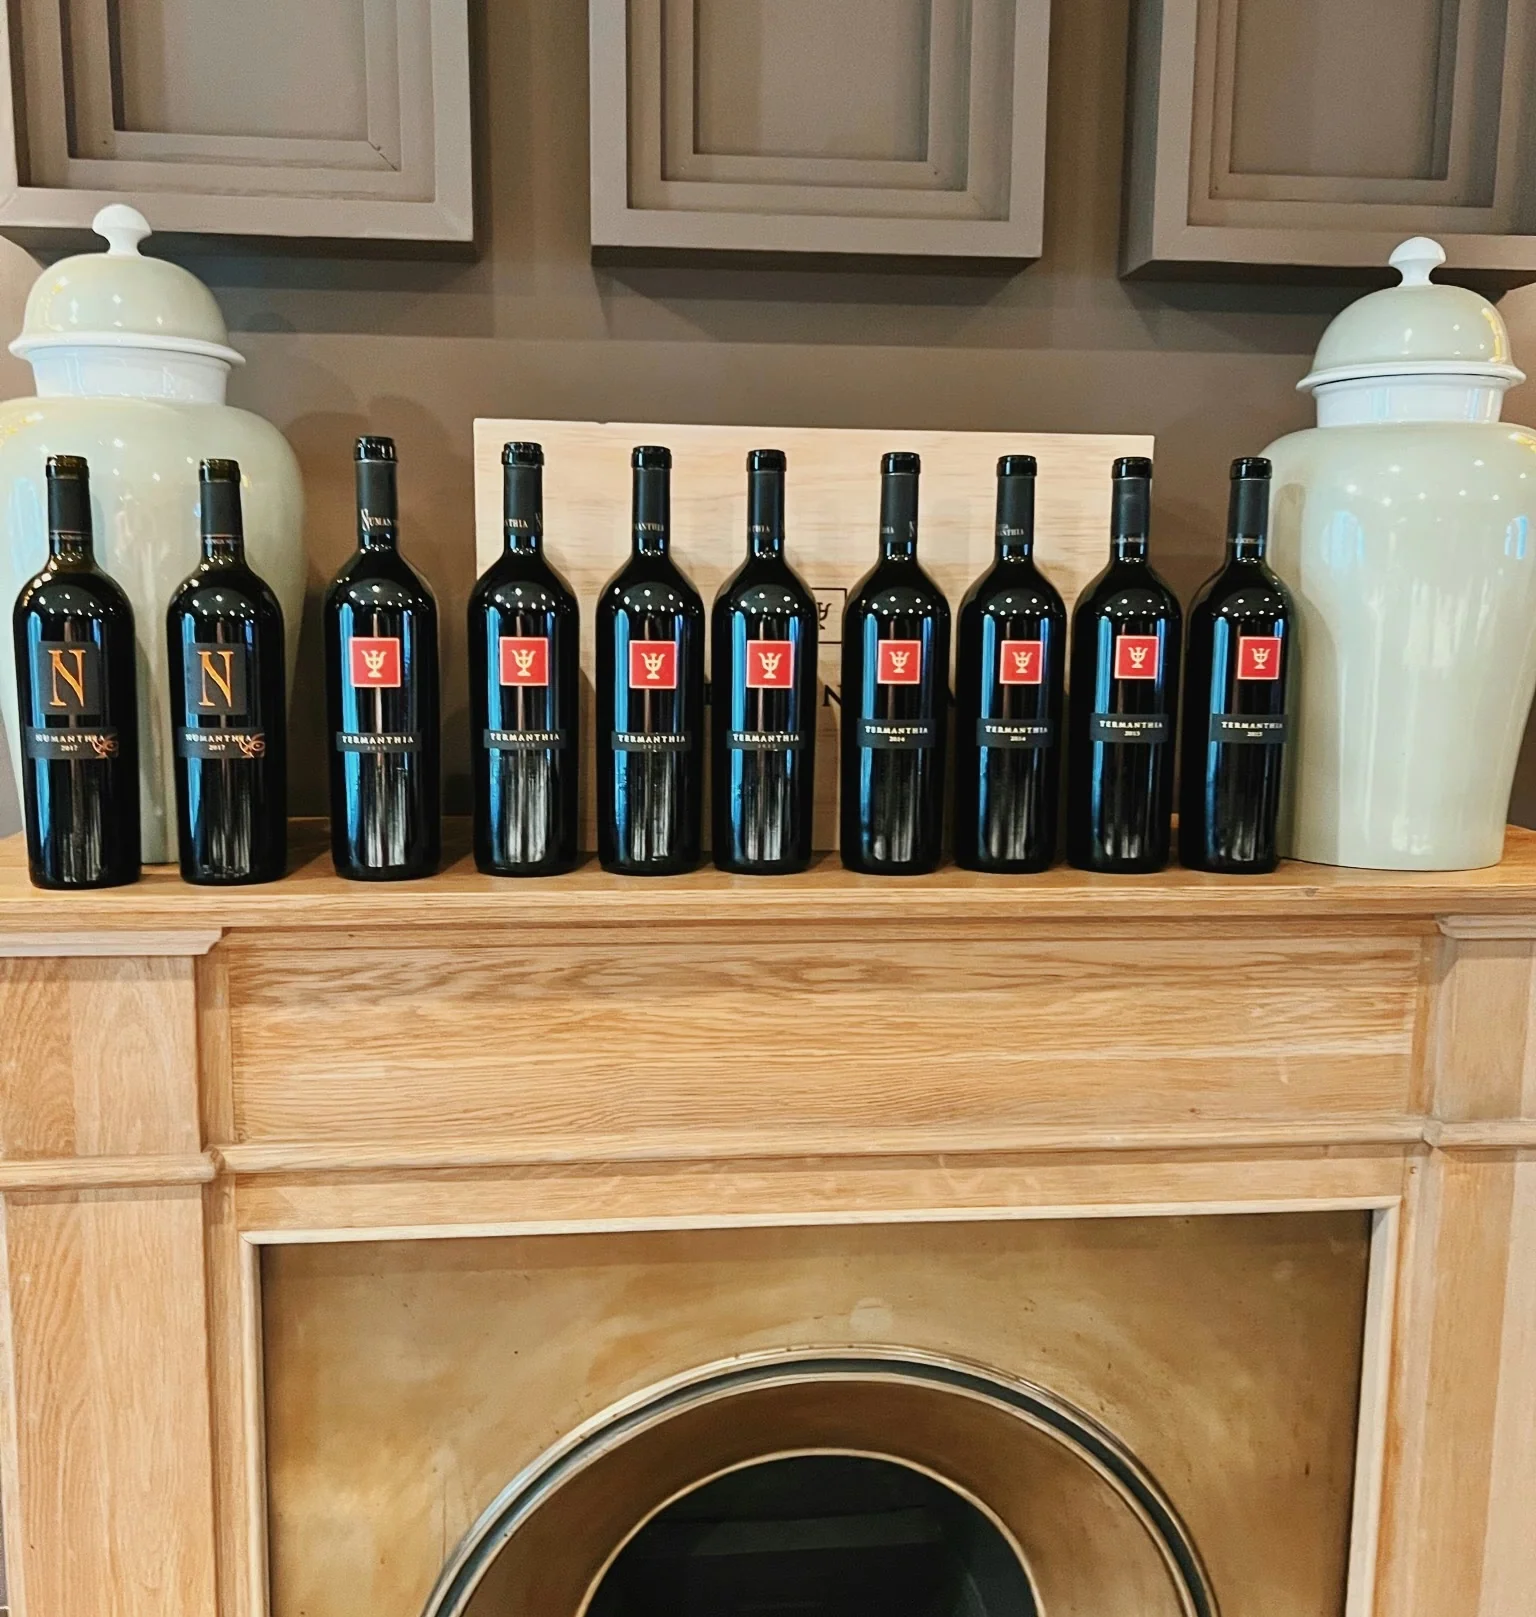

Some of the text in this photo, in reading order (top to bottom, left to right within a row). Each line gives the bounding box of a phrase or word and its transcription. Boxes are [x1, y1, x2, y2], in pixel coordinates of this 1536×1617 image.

[48, 649, 86, 707] N
[197, 650, 234, 708] N
[1099, 720, 1163, 729] TERMANTHIA
[1221, 721, 1283, 729] TERMANTHIA
[865, 725, 928, 735] TERMANTHIA
[985, 725, 1048, 734] TERMANTHIA
[342, 735, 414, 744] TERMANTHIA
[490, 732, 560, 742] TERMANTHIA
[618, 734, 686, 743] TERMANTHIA
[733, 733, 799, 742] TERMANTHIA
